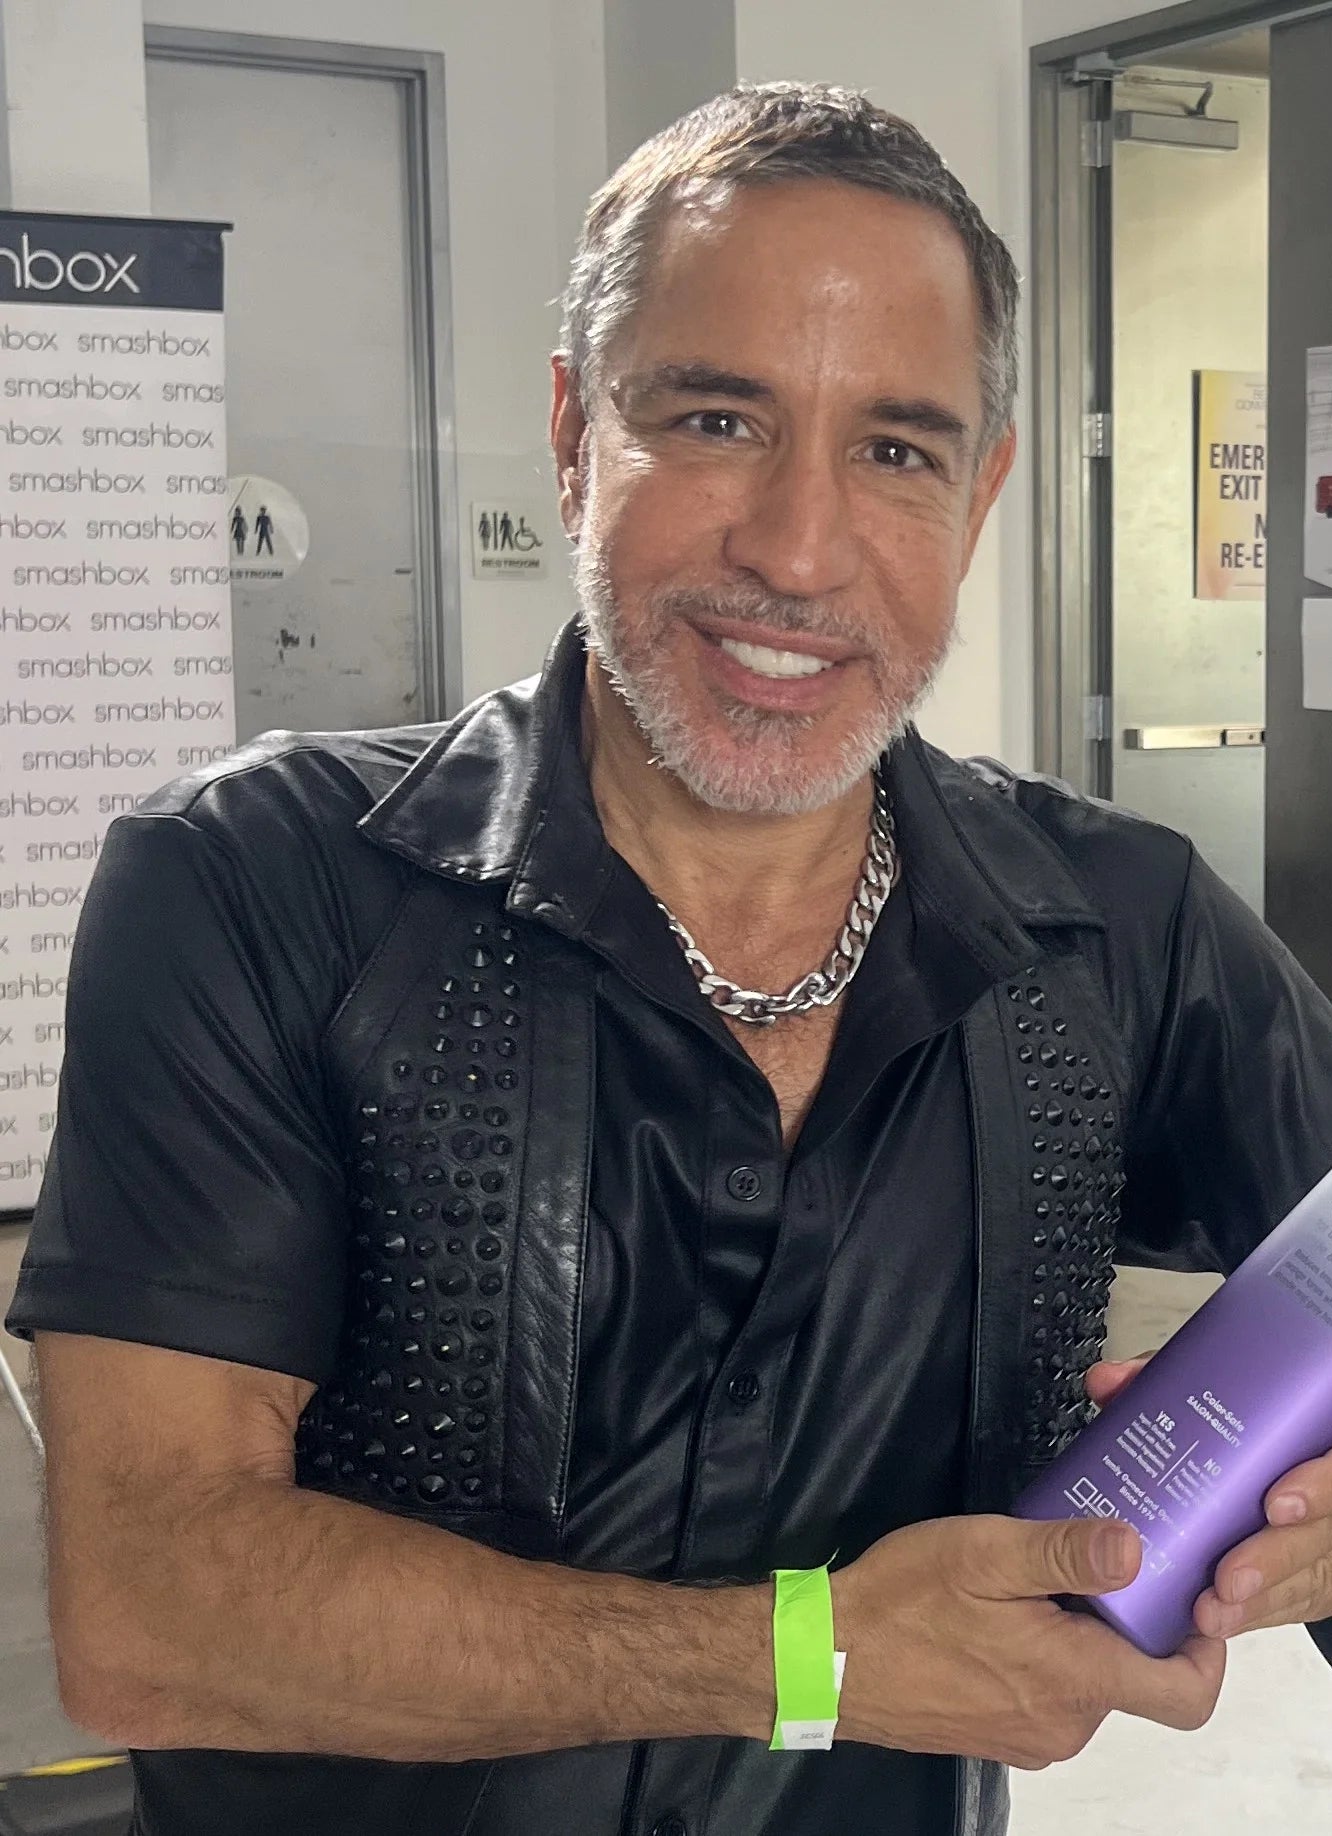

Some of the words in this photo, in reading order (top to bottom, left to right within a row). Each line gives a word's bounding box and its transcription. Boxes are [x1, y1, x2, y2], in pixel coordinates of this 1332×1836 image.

[78, 329, 211, 358] smashbox
[4, 374, 142, 402] smashbox
[162, 381, 224, 403] smas
[82, 422, 214, 450] smashbox
[1210, 443, 1264, 470] EMER
[9, 467, 146, 495] smashbox
[166, 473, 226, 495] smas
[1220, 474, 1262, 501] EXIT
[86, 514, 218, 541] smashbox
[481, 559, 539, 569] RESTROOM
[1221, 542, 1264, 569] RE-E
[13, 560, 150, 587] smashbox
[170, 566, 229, 586] smas
[91, 605, 221, 632] smashbox
[18, 651, 153, 679] smashbox
[174, 655, 232, 677] smas
[95, 696, 224, 723] smashbox
[22, 743, 156, 772] smashbox
[0, 882, 83, 910] shbox
[1154, 1411, 1176, 1433] YES
[1186, 1395, 1243, 1449] SALON-QUALITY
[1203, 1458, 1223, 1477] NO
[1119, 1485, 1139, 1506] Since
[1121, 1472, 1146, 1499] Owned
[1143, 1495, 1160, 1512] and
